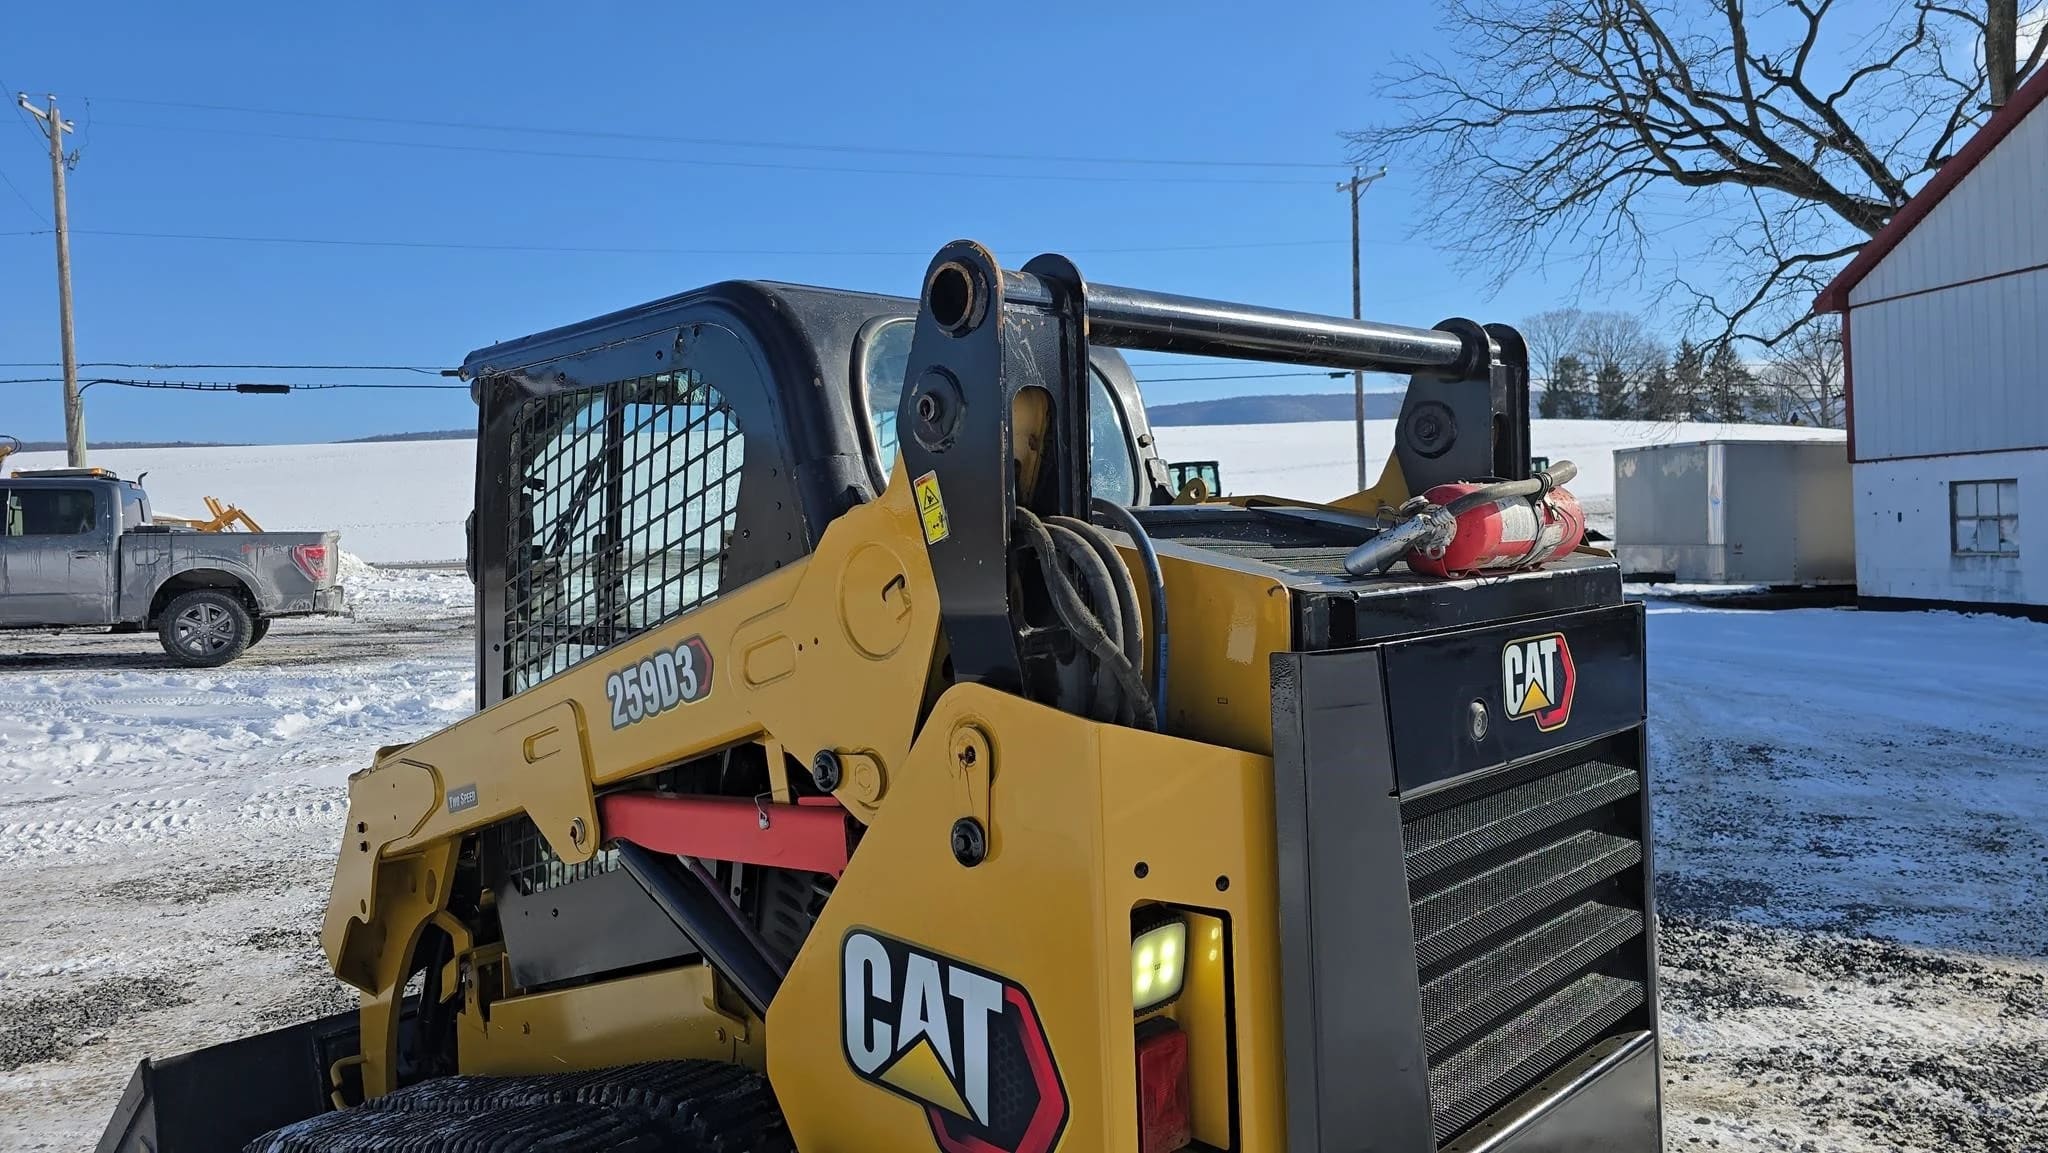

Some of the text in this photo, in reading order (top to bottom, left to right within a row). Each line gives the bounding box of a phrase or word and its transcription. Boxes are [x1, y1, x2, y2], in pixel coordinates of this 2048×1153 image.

[607, 645, 698, 728] 259D3
[1504, 638, 1557, 716] CAT
[844, 933, 1003, 1128] CAT
